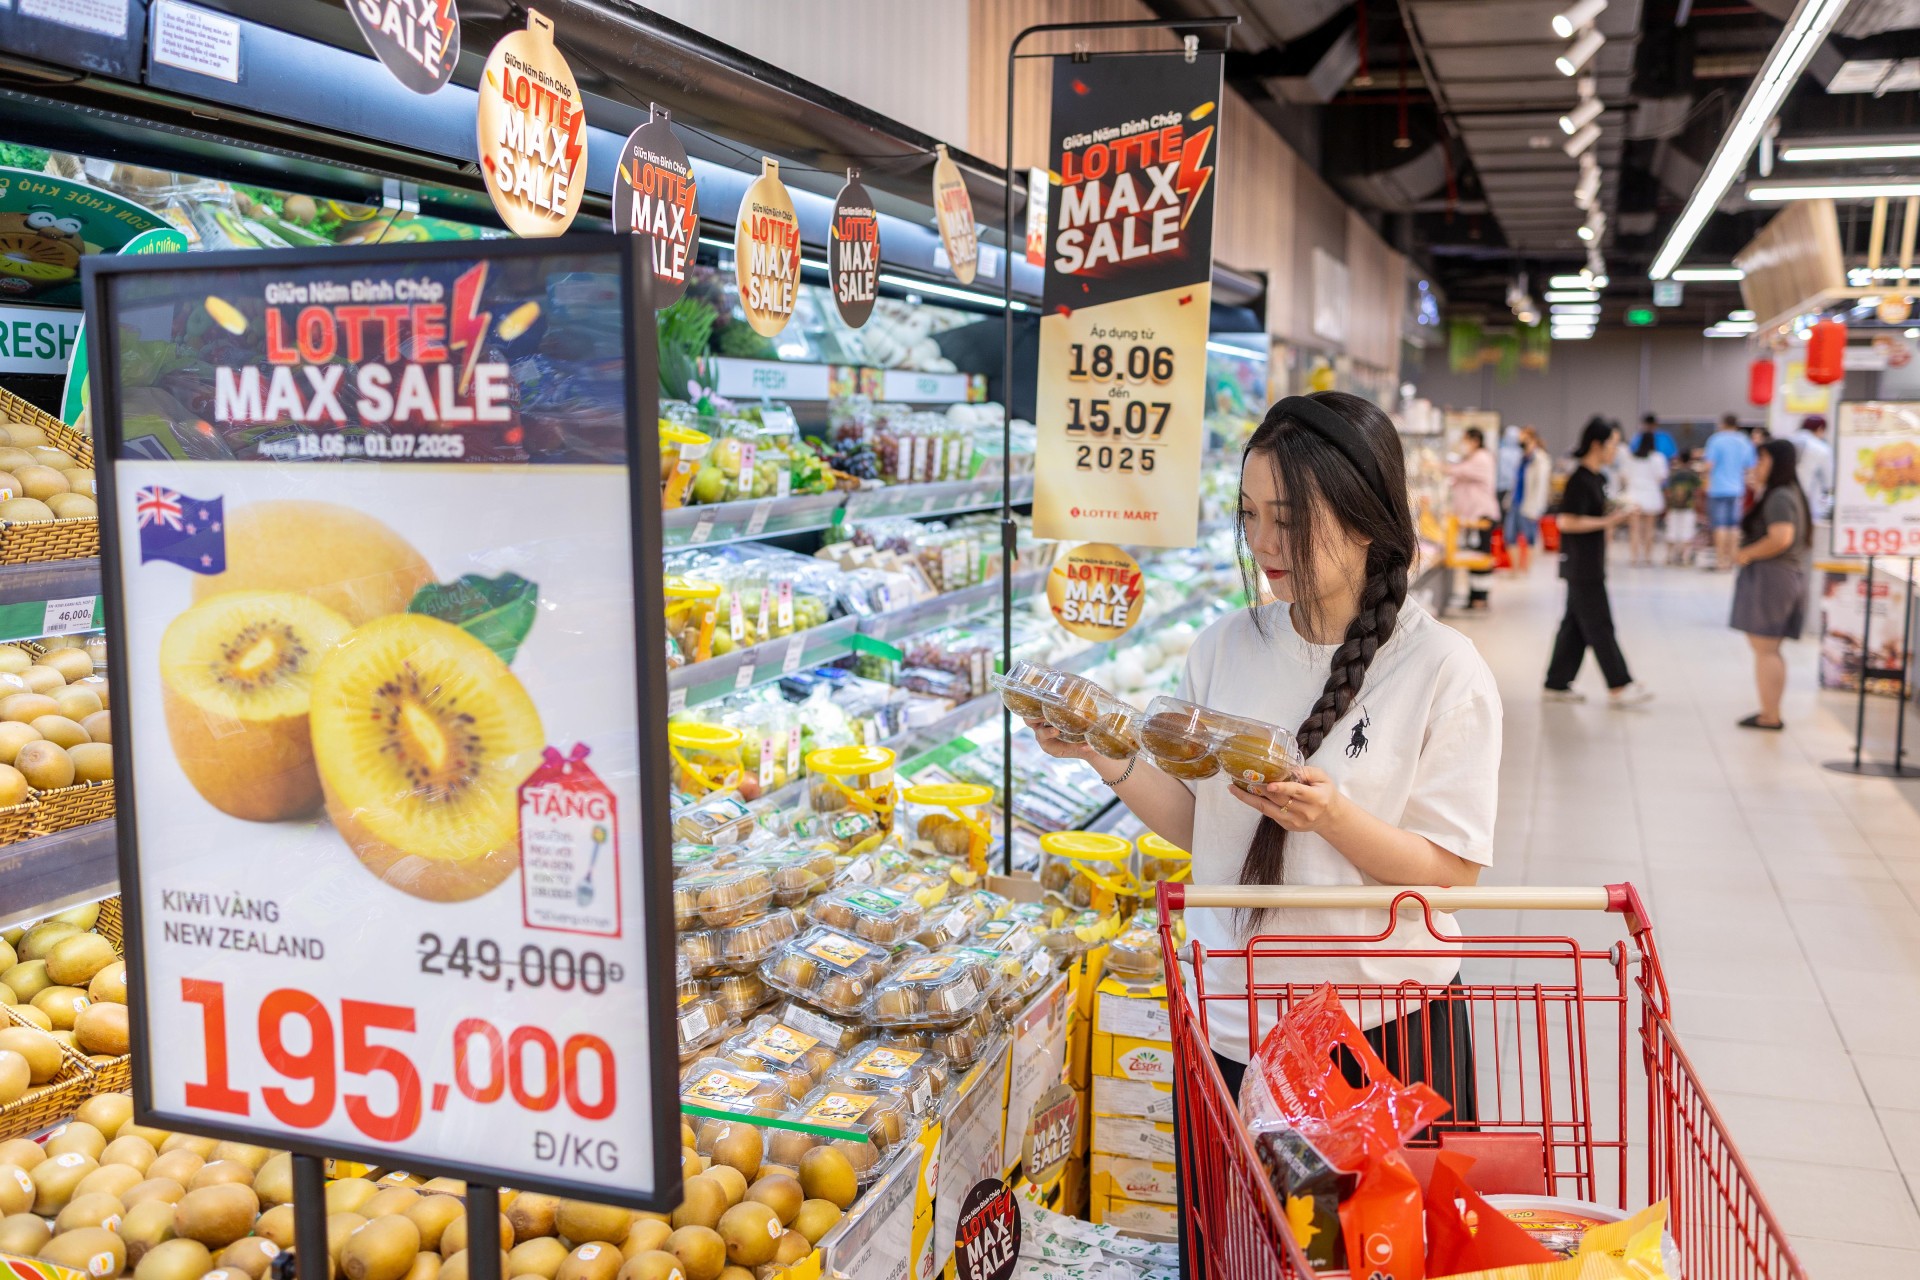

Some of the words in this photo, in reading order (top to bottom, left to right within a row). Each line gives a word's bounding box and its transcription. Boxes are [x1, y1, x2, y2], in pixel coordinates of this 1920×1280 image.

[504, 51, 521, 71] Giữa
[522, 62, 538, 79] Năm
[555, 78, 572, 98] Chóp
[503, 67, 572, 131] LOTTE
[499, 107, 570, 173] MAX
[1063, 131, 1091, 150] Giữa
[1093, 126, 1120, 144] Năm
[1121, 119, 1149, 137] Đỉnh
[1150, 111, 1182, 128] Chóp
[1061, 125, 1184, 186] LOTTE
[496, 149, 570, 216] SALE
[632, 158, 687, 207] LOTTE
[1058, 161, 1180, 230] MAX
[631, 190, 686, 243] MAX
[752, 214, 793, 249] LOTTE
[839, 216, 873, 241] LOTTE
[839, 241, 873, 271] MAX
[1054, 206, 1180, 275] SALE
[751, 241, 793, 281] MAX
[265, 283, 309, 304] Giữa
[310, 284, 350, 302] Năm
[350, 280, 393, 301] Đỉnh
[394, 277, 444, 303] Chóp
[749, 275, 793, 314] SALE
[838, 271, 875, 303] SALE
[264, 304, 448, 365] LOTTE
[1089, 326, 1106, 339] Áp
[1108, 328, 1138, 341] dụng
[1142, 328, 1155, 340] từ
[1070, 343, 1174, 381] 18.06
[215, 364, 348, 422] MAX
[356, 363, 512, 422] SALE
[1108, 386, 1130, 399] đến
[1066, 397, 1172, 436] 15.07
[297, 434, 345, 457] 18.06
[1076, 446, 1156, 472] 2025
[1082, 510, 1121, 521] LOTTE
[1123, 510, 1159, 521] MART
[1065, 580, 1130, 606] MAX
[1067, 563, 1131, 585] LOTTE
[1061, 600, 1129, 627] SALE
[530, 790, 606, 822] TẶNG
[161, 889, 212, 915] KIWI
[214, 890, 279, 923] VÀNG
[163, 921, 214, 948] NEW
[218, 928, 325, 961] ZEALAND
[179, 976, 619, 1143] 195,000
[1129, 1057, 1163, 1072] Zespri
[533, 1131, 620, 1172] Đ/KG
[1031, 1133, 1070, 1174] SALE
[1033, 1114, 1070, 1155] MAX
[962, 1195, 1005, 1245] LOTTE
[967, 1213, 1009, 1268] MAX
[970, 1234, 1014, 1280] SALE
